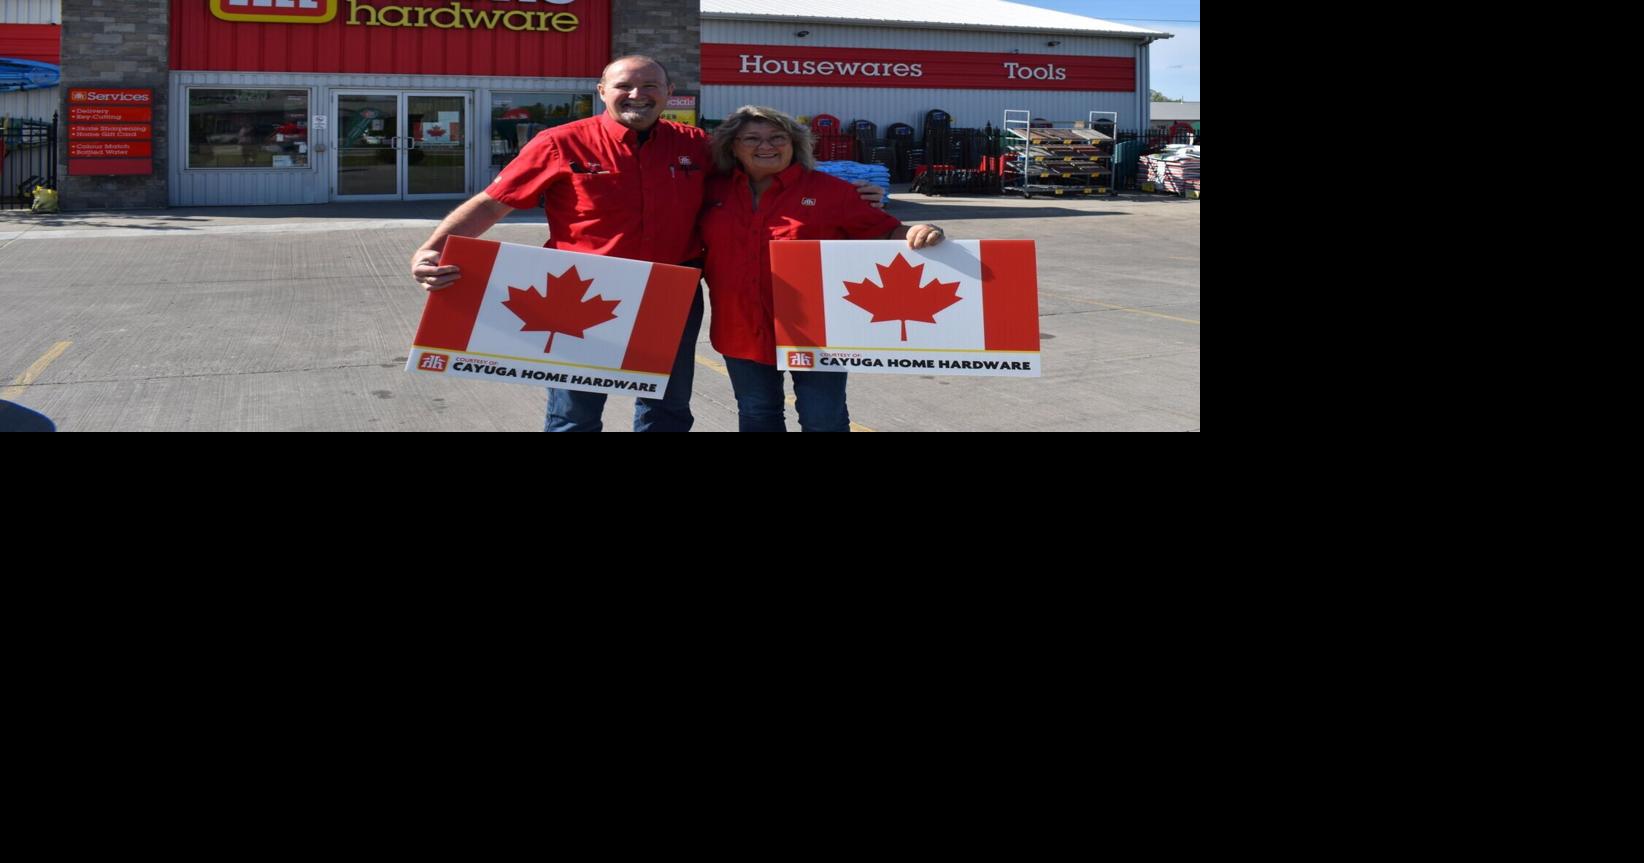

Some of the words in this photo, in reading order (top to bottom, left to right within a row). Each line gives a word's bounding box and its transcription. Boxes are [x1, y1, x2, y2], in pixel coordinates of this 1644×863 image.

[346, 0, 579, 32] hardware
[739, 55, 923, 78] Housewares
[1004, 62, 1066, 81] Tools
[87, 91, 150, 101] Services
[456, 356, 489, 365] COURTESY
[820, 357, 884, 367] CAYUGA
[887, 358, 935, 369] HOME
[938, 360, 1031, 370] HARDWARE
[453, 362, 517, 378] CAYUGA
[521, 369, 568, 383] HOME
[570, 375, 657, 393] HARDWARE
